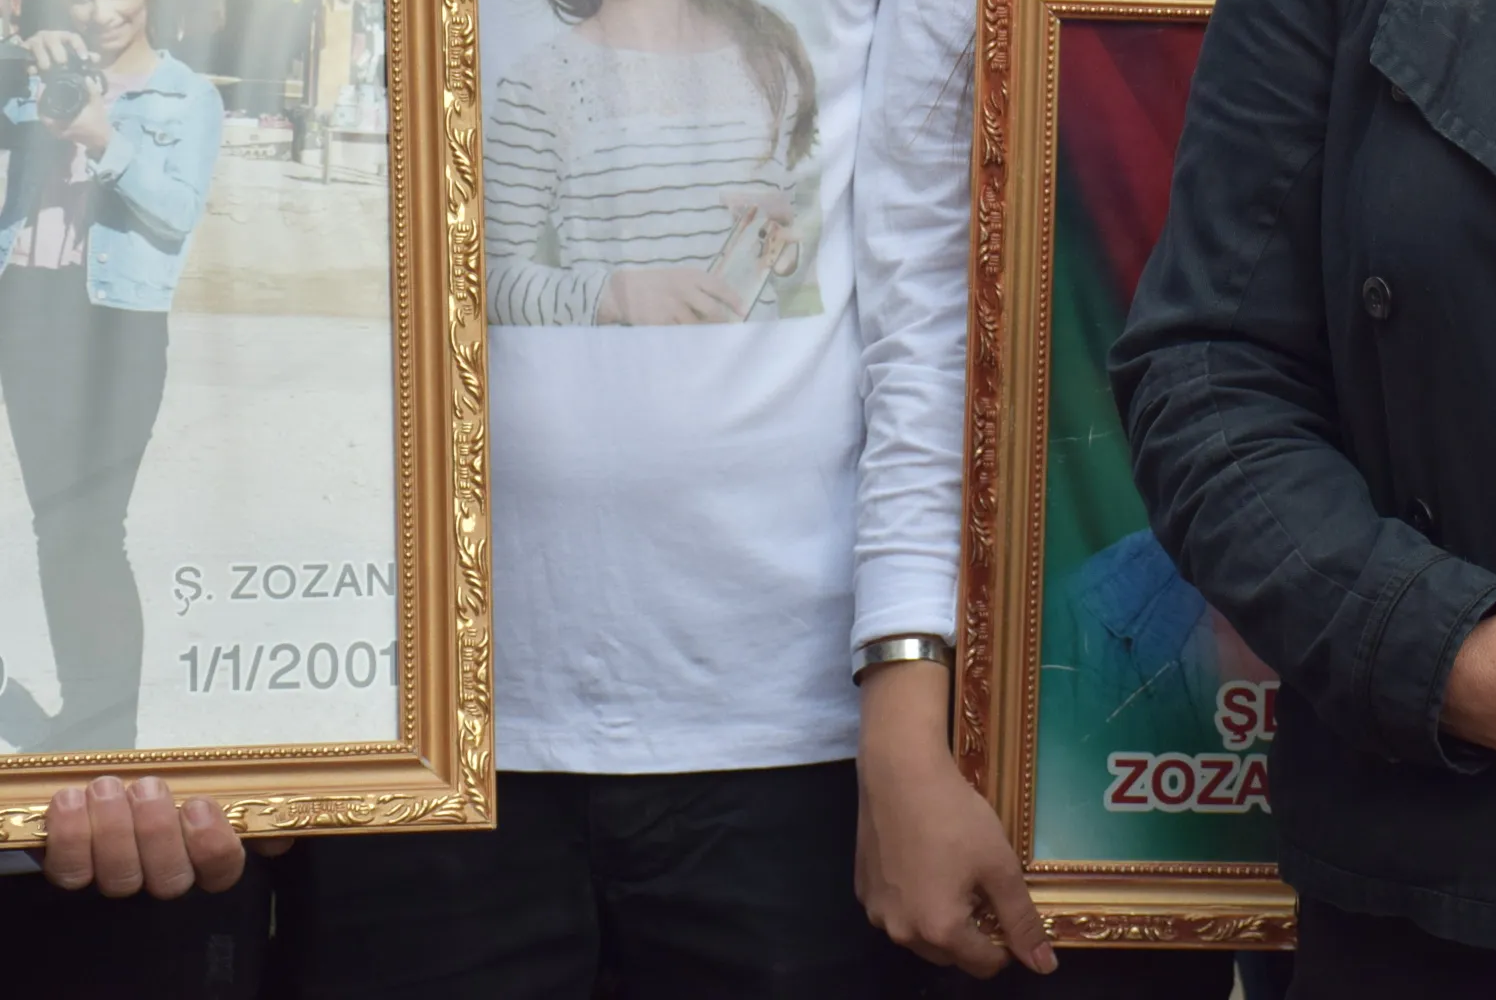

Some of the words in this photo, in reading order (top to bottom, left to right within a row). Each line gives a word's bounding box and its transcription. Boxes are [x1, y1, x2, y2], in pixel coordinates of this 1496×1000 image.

[174, 566, 213, 616] Ş.
[230, 563, 397, 600] ZOZAN
[179, 641, 398, 692] 1/1/2001
